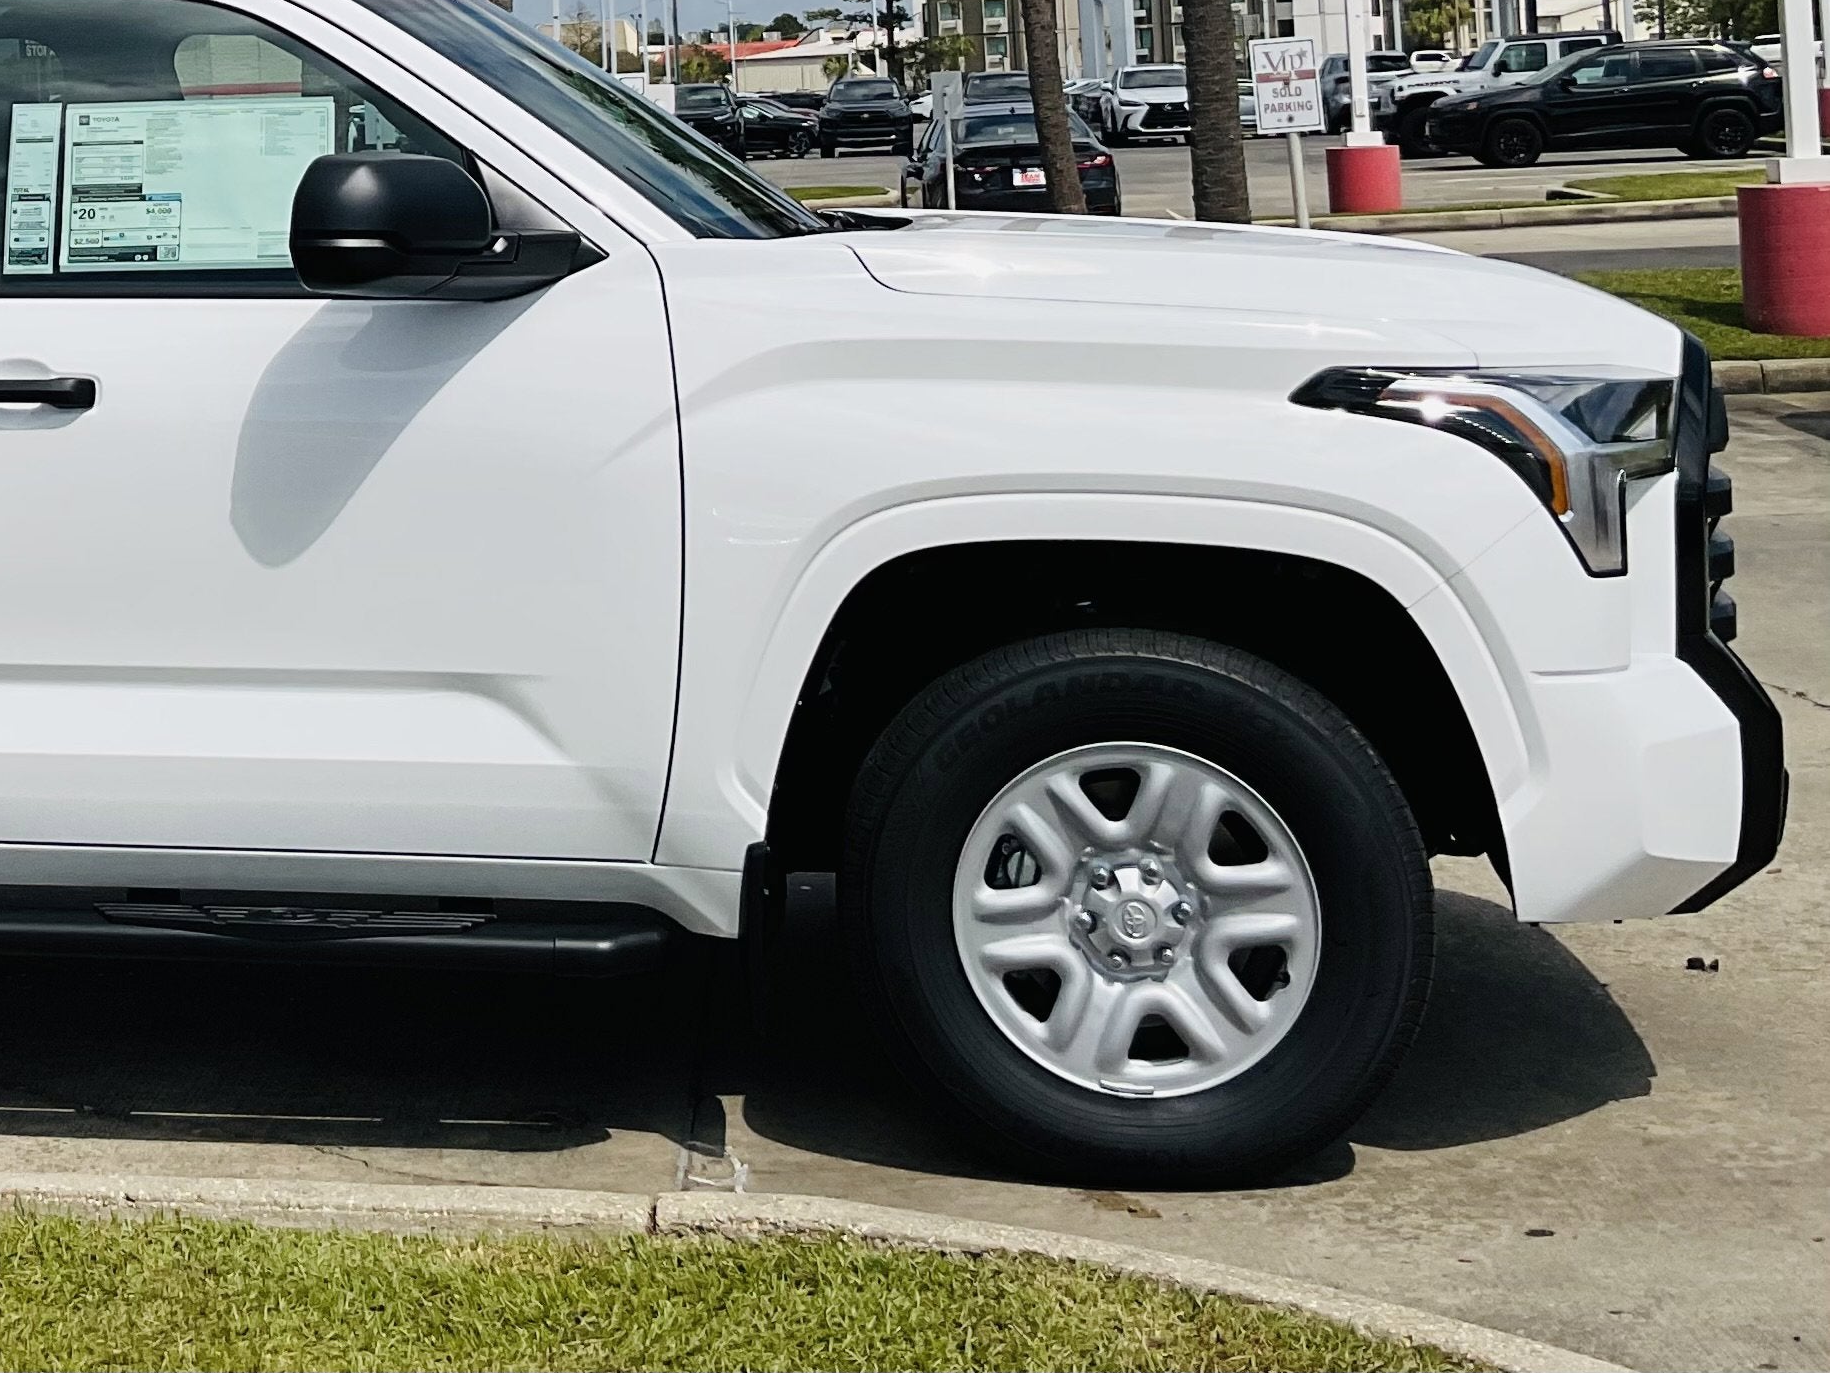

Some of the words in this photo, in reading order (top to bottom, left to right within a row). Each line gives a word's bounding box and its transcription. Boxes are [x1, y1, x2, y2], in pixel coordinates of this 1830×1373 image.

[1272, 86, 1302, 98] SOLD
[1263, 100, 1313, 114] PARKING
[78, 208, 96, 220] 20
[935, 672, 1206, 773] GEOLANDAR
